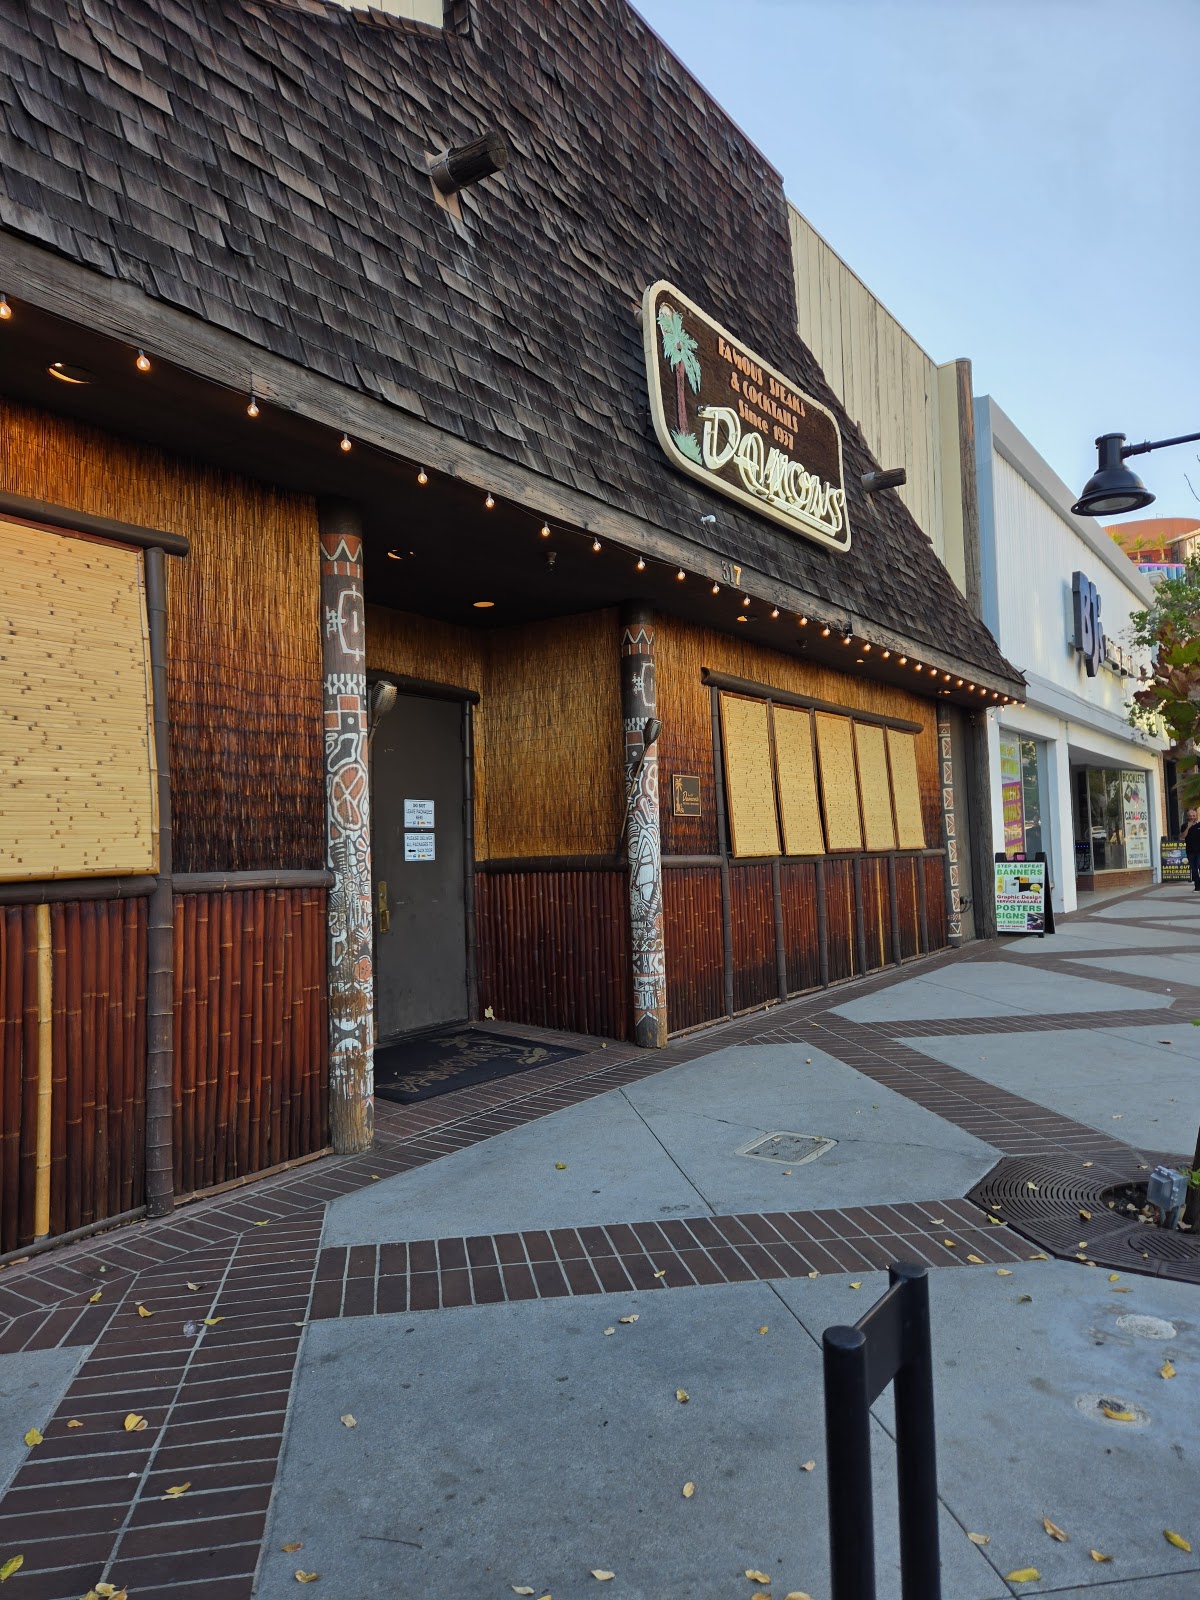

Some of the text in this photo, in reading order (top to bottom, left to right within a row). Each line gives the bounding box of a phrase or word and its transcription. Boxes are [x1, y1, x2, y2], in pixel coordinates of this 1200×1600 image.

[718, 336, 806, 418] FAMOUS STEAKS
[730, 371, 799, 433] & COCKTAILS
[738, 398, 794, 450] Since 1937
[721, 560, 742, 586] 317
[1122, 773, 1145, 784] BOOKLETS
[1125, 811, 1147, 820] CATALOGS
